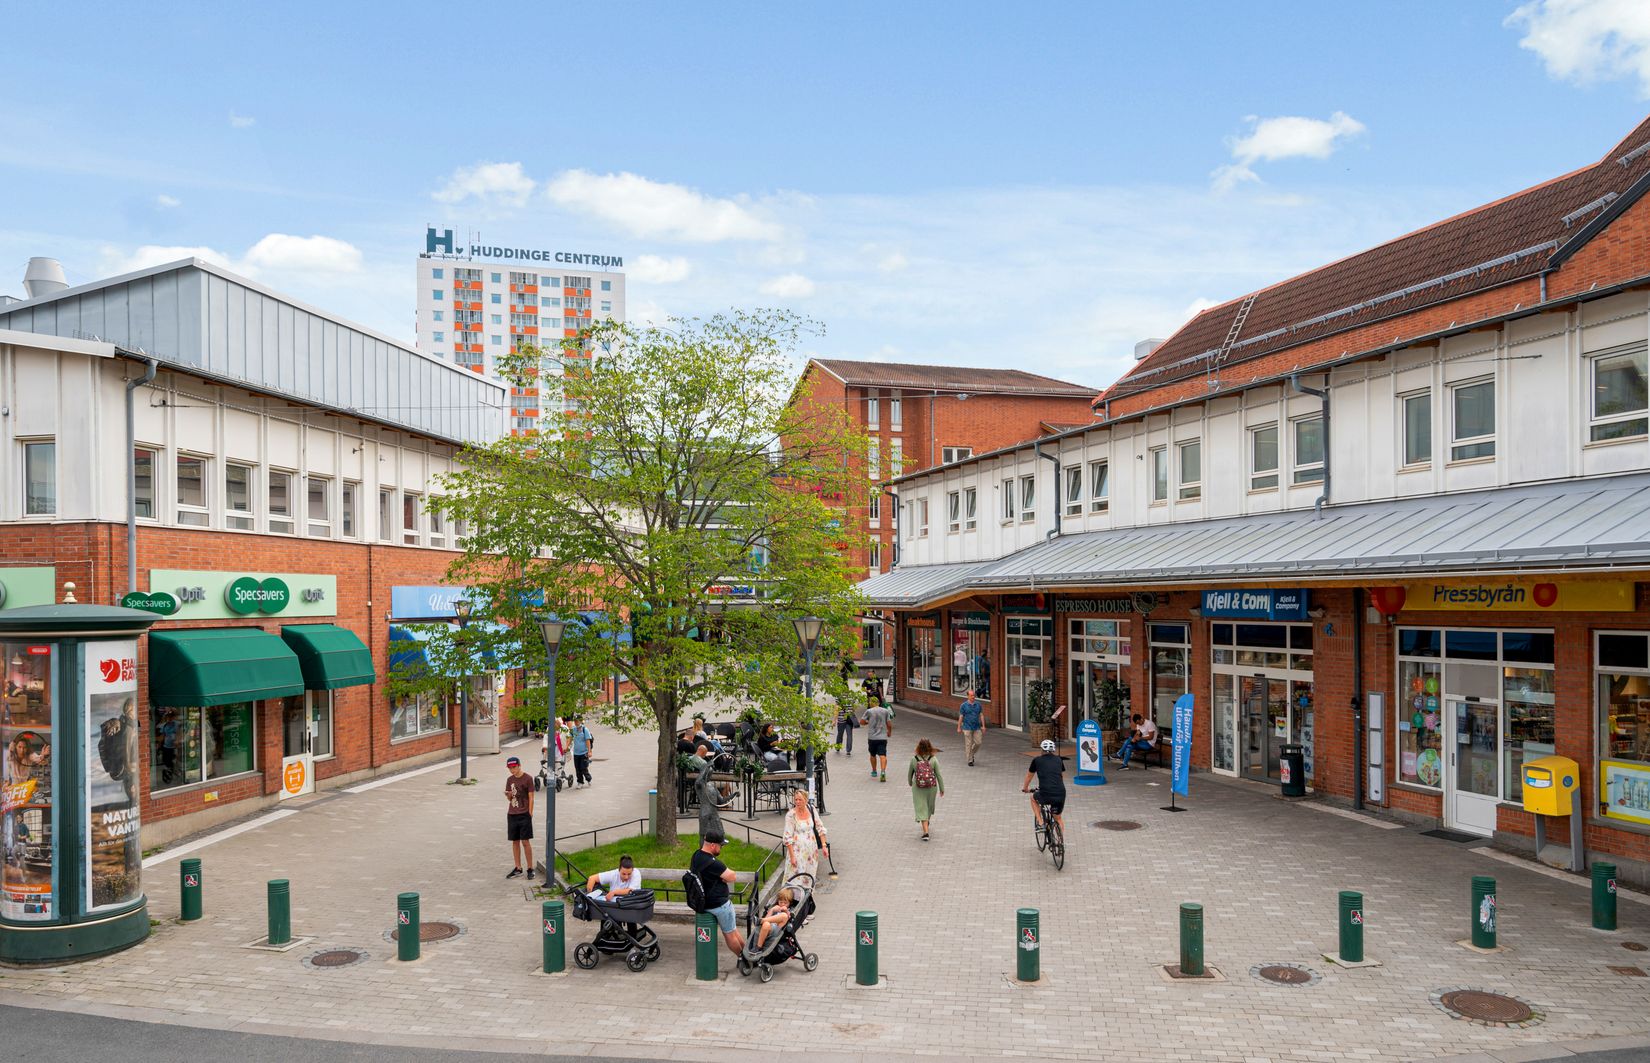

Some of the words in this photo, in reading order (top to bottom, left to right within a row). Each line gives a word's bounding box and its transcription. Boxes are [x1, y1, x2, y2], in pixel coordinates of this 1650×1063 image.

[471, 245, 550, 262] HUDDINGE
[555, 252, 623, 267] CENTRUM
[126, 598, 171, 609] Specsavers
[235, 586, 285, 602] Specsavers
[1206, 592, 1232, 612] Kjell
[1232, 592, 1240, 609] &
[1434, 583, 1526, 608] Pressbyrån
[1055, 600, 1097, 613] ESPRESSO
[1098, 600, 1131, 613] HOUSE
[1175, 706, 1184, 744] utanför
